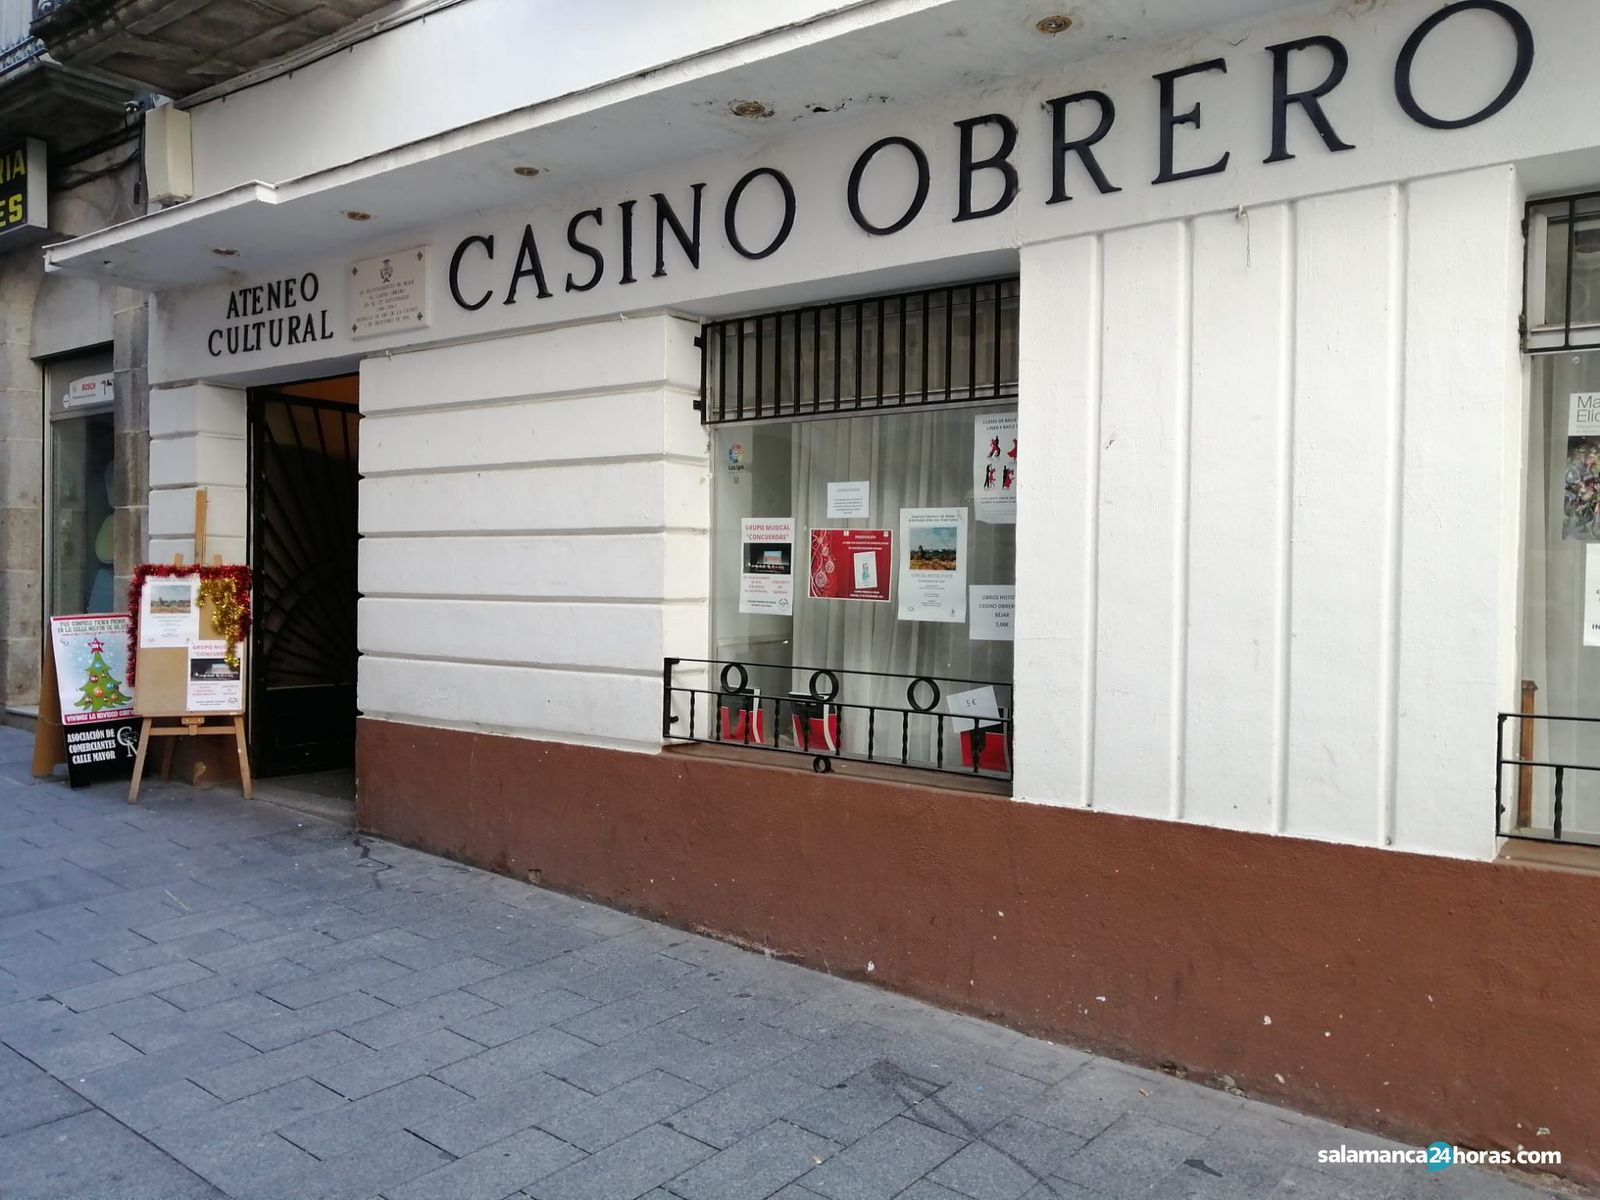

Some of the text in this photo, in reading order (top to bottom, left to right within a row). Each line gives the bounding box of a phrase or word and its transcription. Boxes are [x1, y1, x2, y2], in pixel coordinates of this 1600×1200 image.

[449, 0, 1535, 311] CASINO OBRERO
[226, 272, 319, 319] ATENEO
[208, 310, 333, 357] CULTURAL
[67, 729, 115, 743] ASOCIACIÓN DE
[69, 739, 116, 754] COMERCIANTES
[72, 750, 116, 765] CALLE MAYOR
